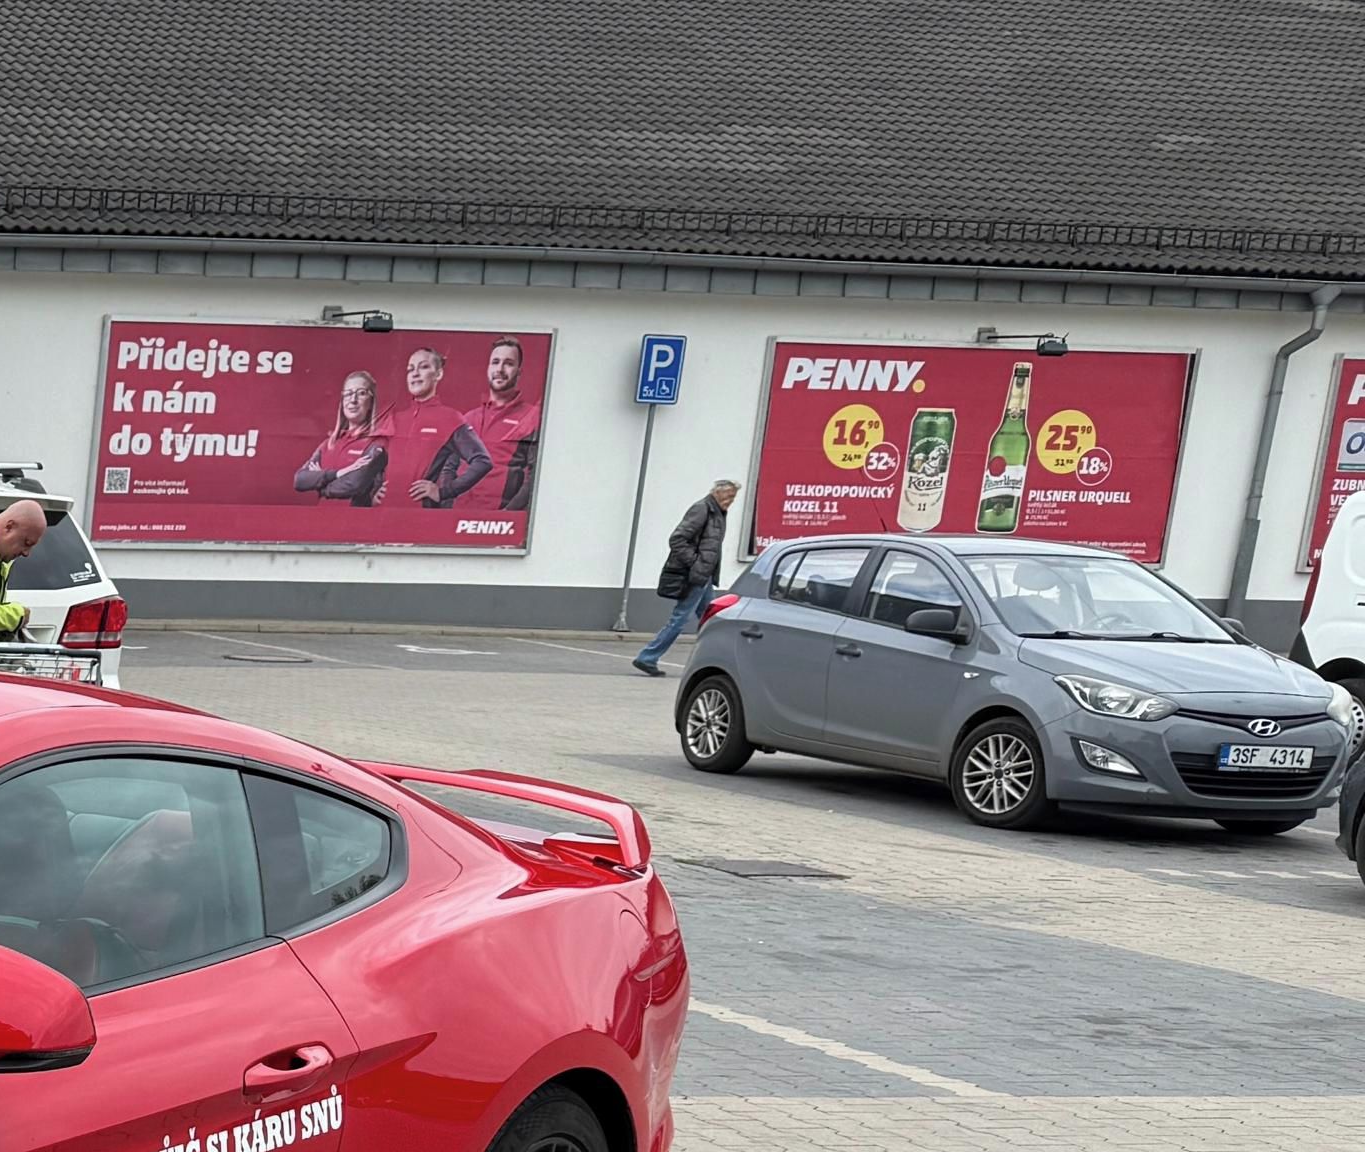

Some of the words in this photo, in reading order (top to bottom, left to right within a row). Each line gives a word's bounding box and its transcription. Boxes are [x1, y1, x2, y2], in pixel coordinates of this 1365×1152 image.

[117, 337, 250, 379] Přidejte
[255, 350, 294, 375] se
[648, 344, 675, 382] P
[112, 381, 136, 412] k
[142, 380, 217, 414] nám
[642, 385, 655, 397] 5x
[108, 424, 152, 456] do
[160, 422, 259, 462] týmu!
[867, 452, 897, 471] 32%
[1078, 456, 1108, 475] 18%
[786, 483, 895, 499] VELKOPOPOVICKÝ
[908, 476, 943, 491] Kozel
[783, 501, 821, 513] KOZEL
[823, 501, 838, 513] 11
[1028, 490, 1077, 502] PILSNER
[1078, 491, 1131, 505] URQUELL
[456, 520, 515, 535] PENNY.
[1232, 747, 1260, 764] 3SF
[1269, 748, 1305, 766] 4314
[300, 1085, 344, 1146] SNŮ
